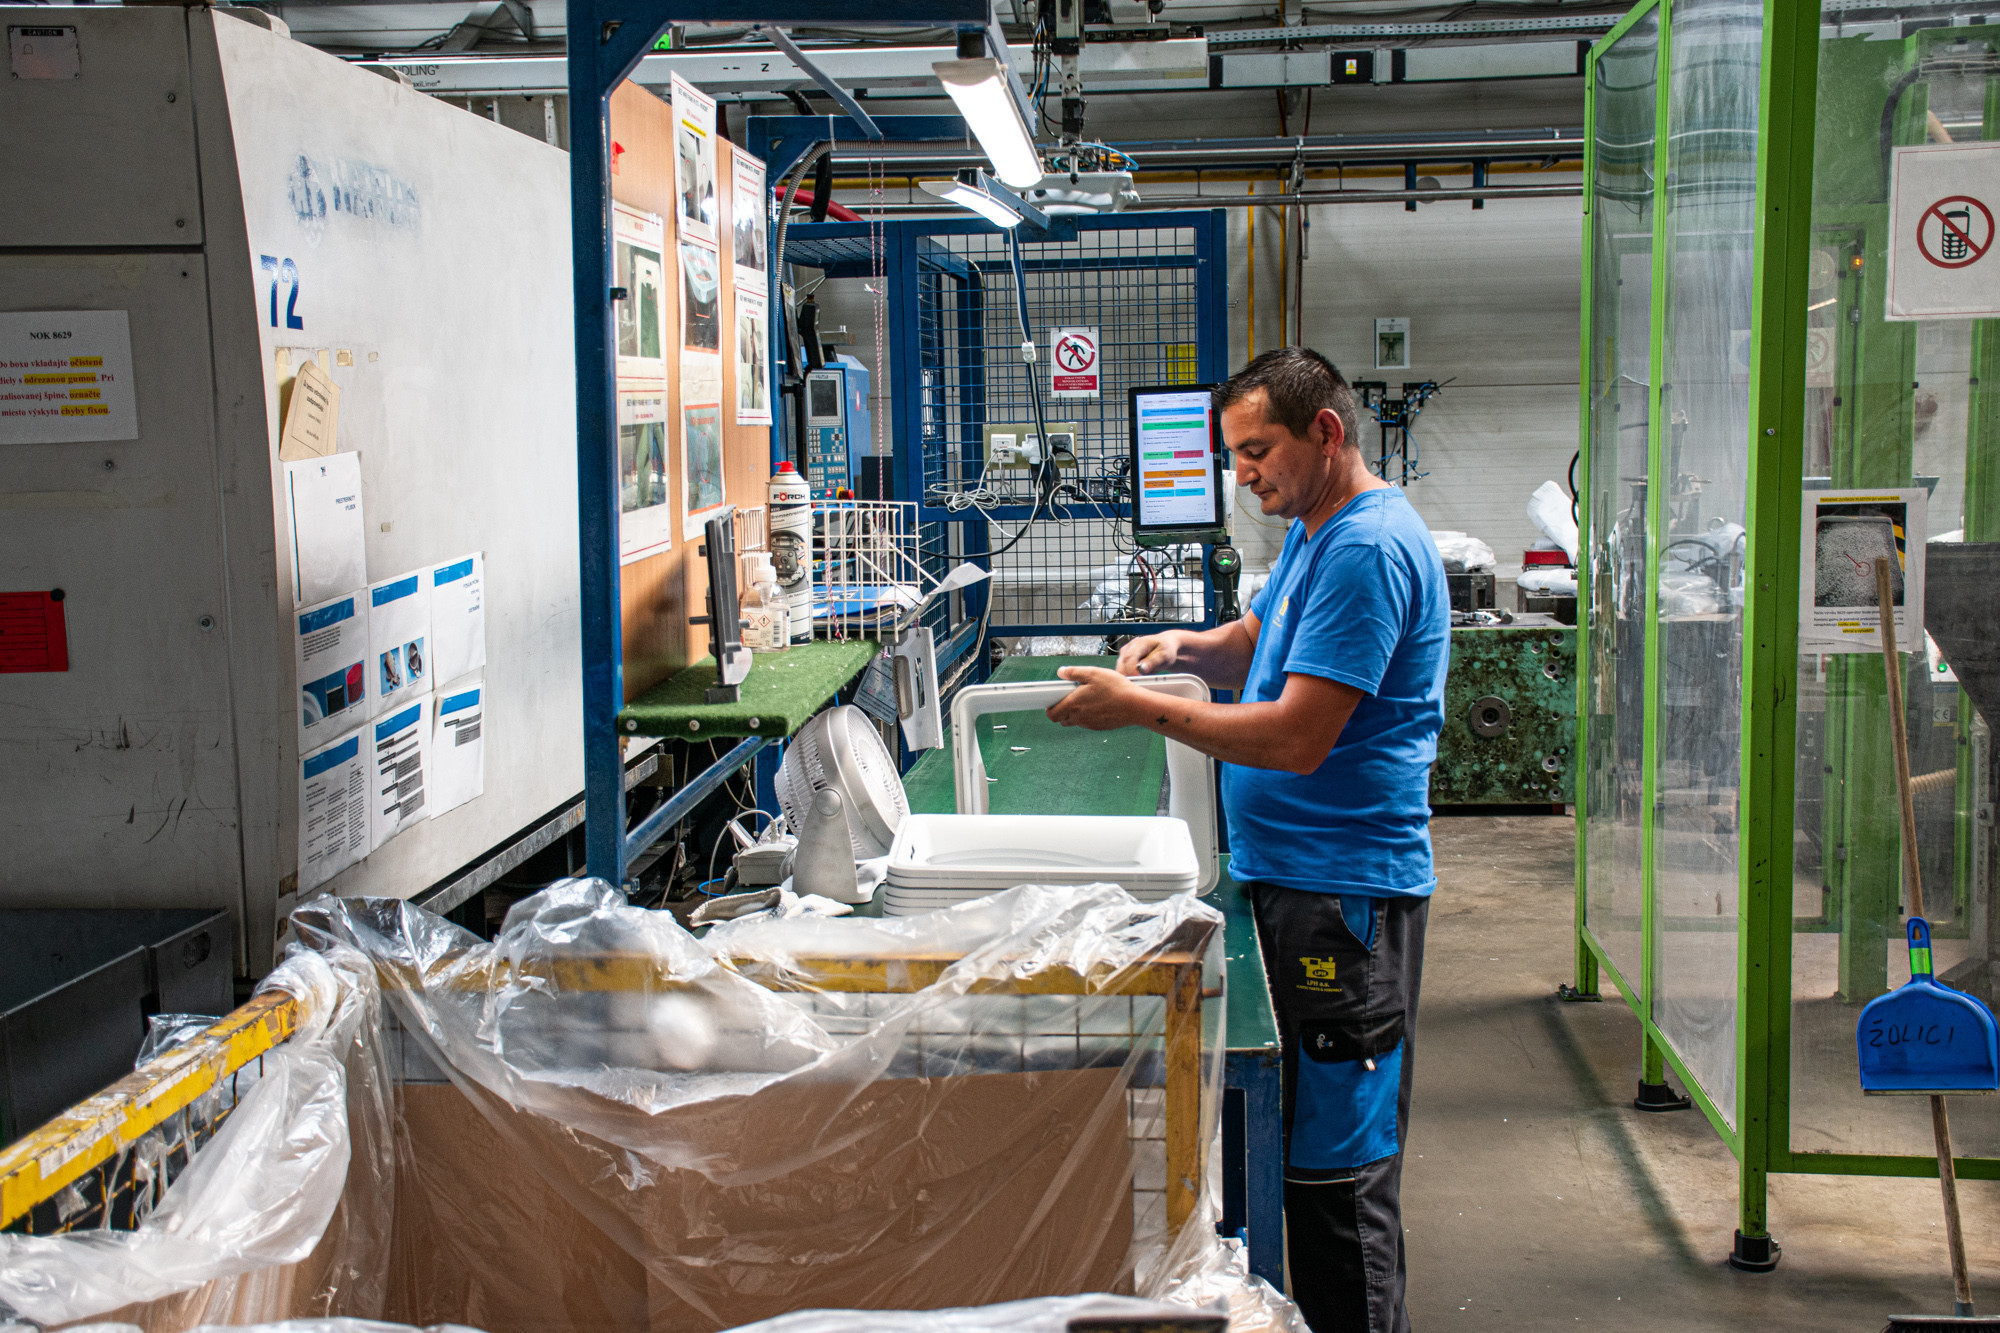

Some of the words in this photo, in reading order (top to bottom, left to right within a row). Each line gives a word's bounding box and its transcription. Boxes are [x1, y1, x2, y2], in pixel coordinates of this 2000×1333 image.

[761, 62, 769, 72] Z
[260, 254, 304, 330] 72
[30, 332, 51, 340] NOK
[53, 331, 72, 339] 8629
[9, 360, 29, 368] boxu
[31, 359, 68, 370] vkladajte
[70, 357, 104, 367] očistené
[24, 375, 66, 384] odrezanou
[101, 374, 115, 382] Pri
[1, 391, 43, 401] zalisovanej
[69, 390, 101, 399] označte
[1, 408, 27, 417] miesto
[28, 407, 59, 418] výskytu
[61, 407, 85, 417] chyby
[87, 406, 111, 415] fixou.
[1306, 979, 1319, 987] LPH
